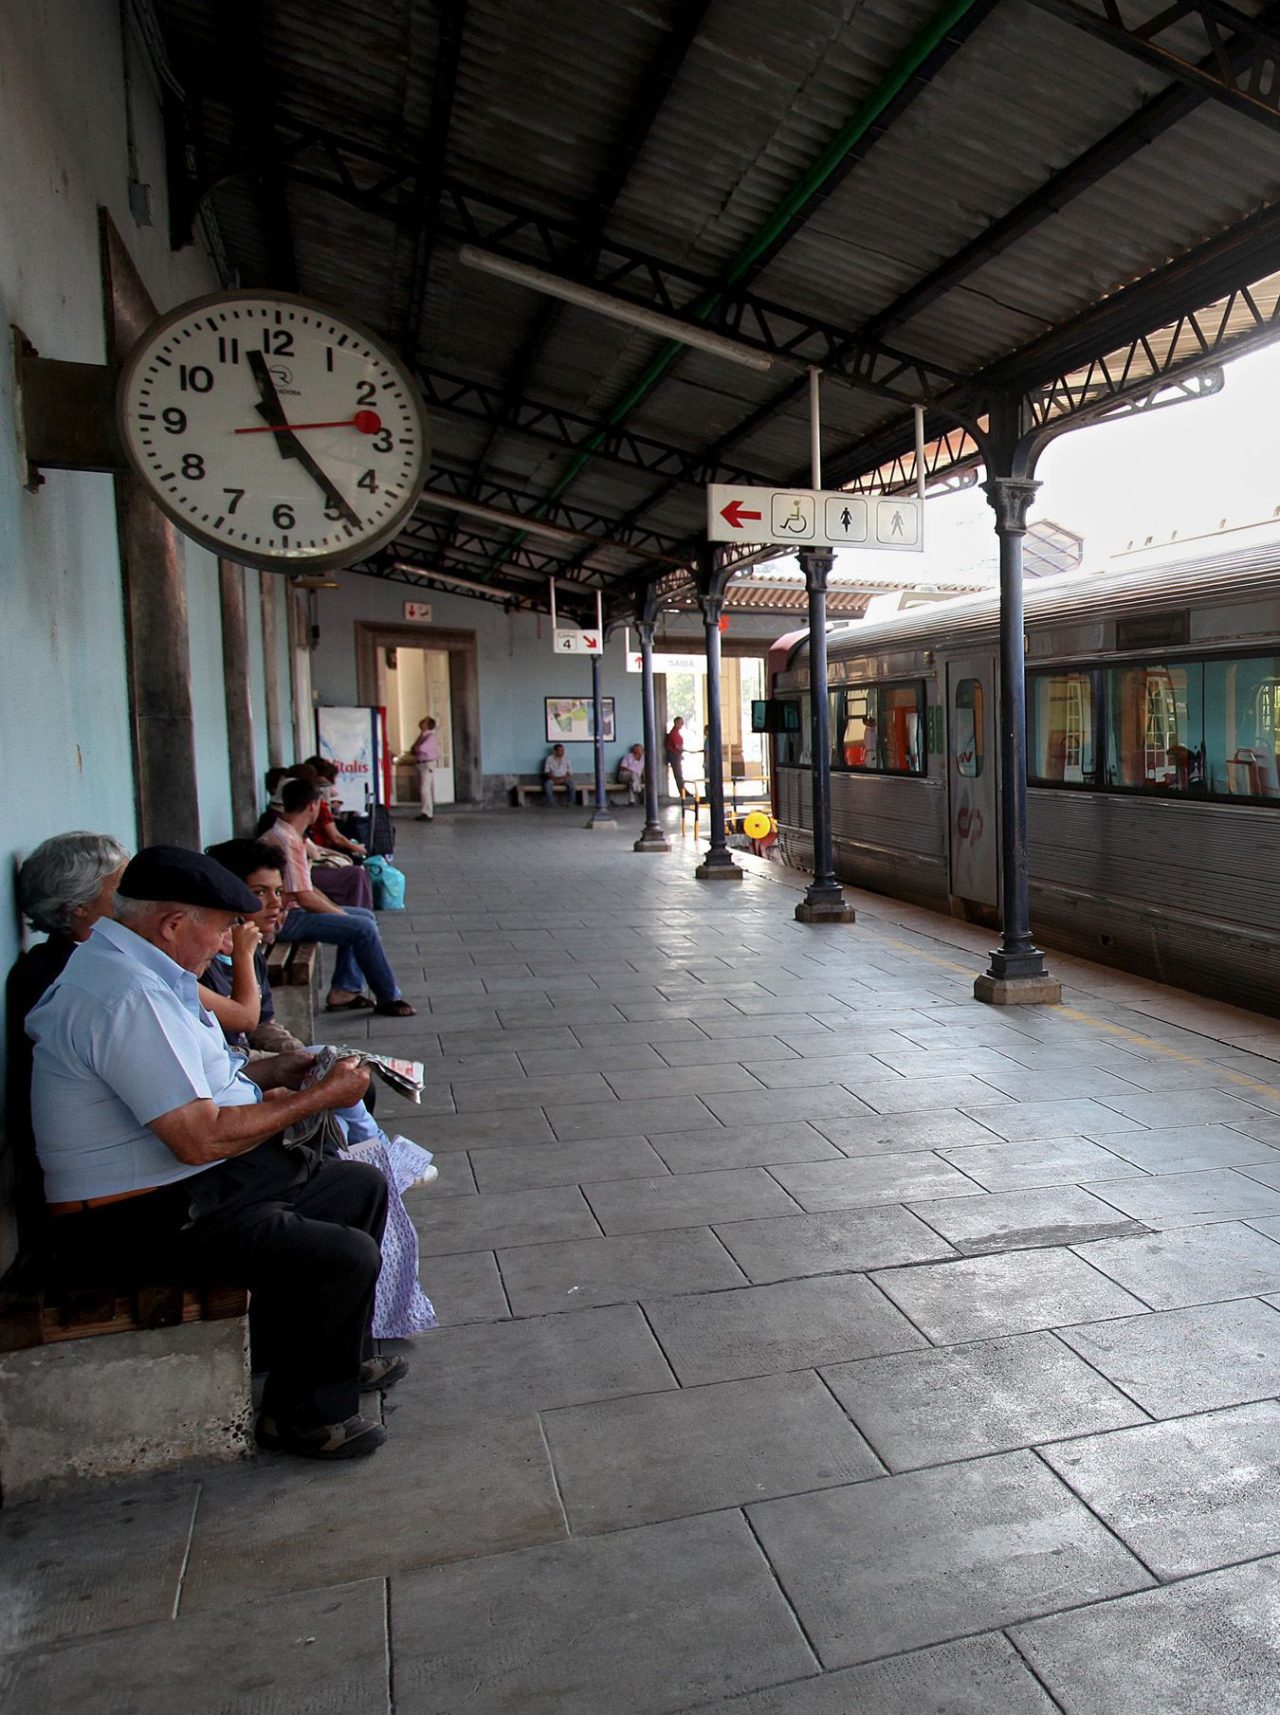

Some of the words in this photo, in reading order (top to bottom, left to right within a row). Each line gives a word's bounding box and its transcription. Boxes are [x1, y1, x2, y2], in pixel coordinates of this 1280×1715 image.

[218, 336, 239, 364] 11
[263, 328, 295, 357] 12
[326, 346, 334, 372] 1
[180, 364, 214, 393] 10
[356, 380, 378, 407] 2
[161, 407, 188, 434] 9
[372, 428, 394, 453] 3
[181, 453, 206, 481] 8
[357, 469, 379, 494] 4
[222, 488, 245, 514] 7
[272, 504, 296, 530] 6
[562, 639, 571, 649] 4
